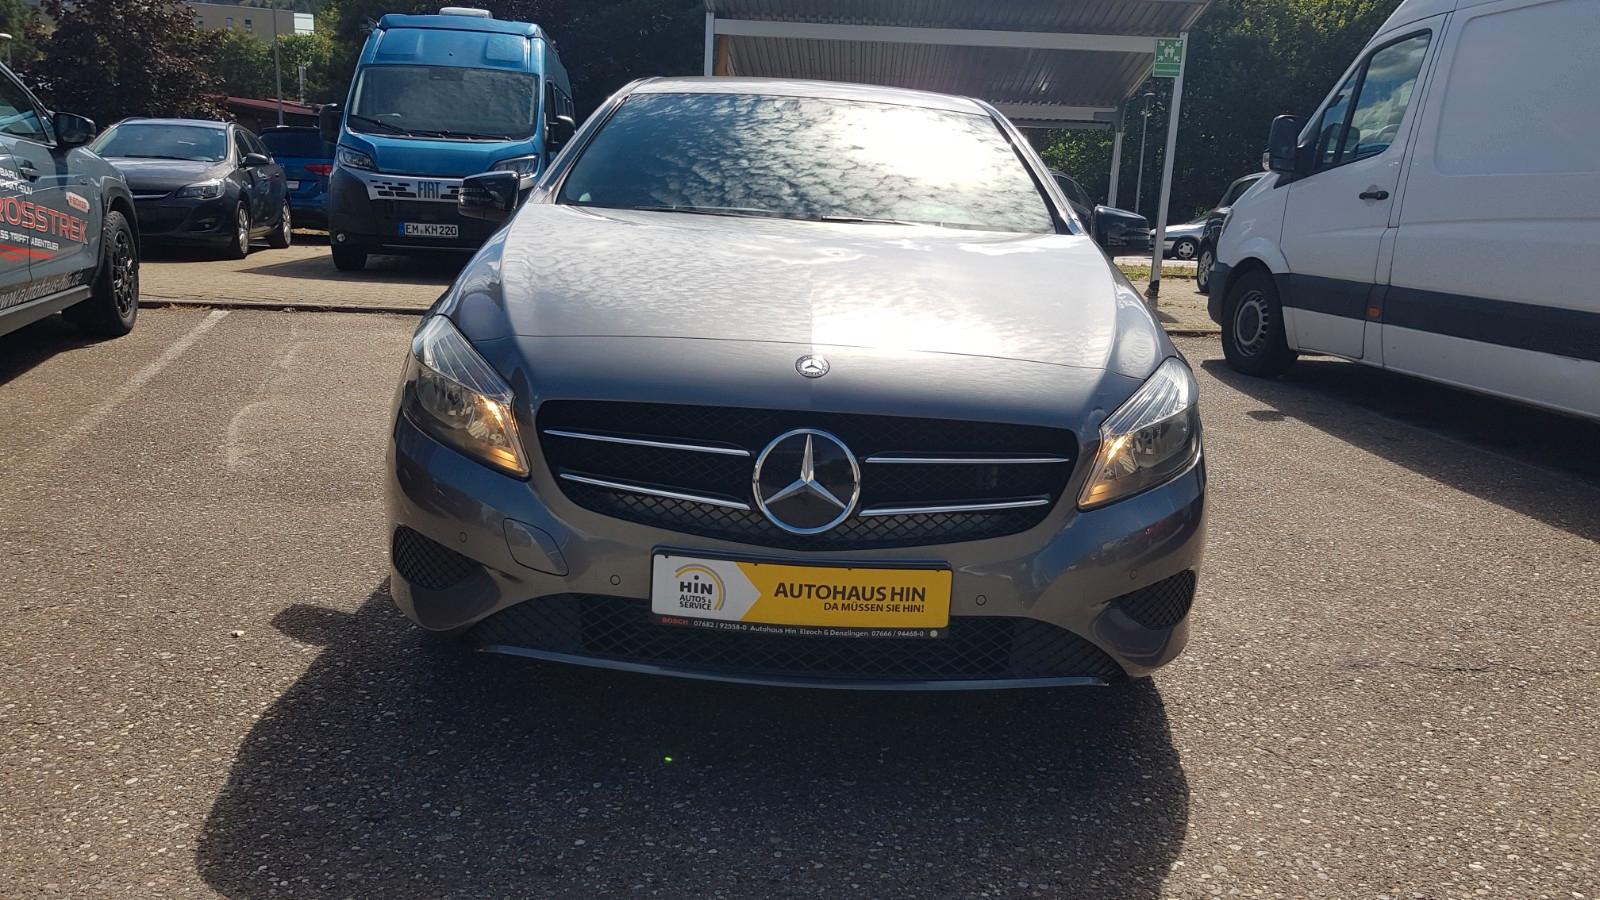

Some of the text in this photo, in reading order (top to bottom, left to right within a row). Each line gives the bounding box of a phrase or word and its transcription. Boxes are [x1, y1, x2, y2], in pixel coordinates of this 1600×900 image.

[417, 181, 440, 199] FIAT
[774, 582, 926, 602] AUTOHAUS HIN
[679, 594, 706, 603] AUTOS
[679, 601, 712, 611] SERVICE
[823, 601, 925, 613] DA MÜSSEN SIE HIN!
[750, 625, 784, 634] Autohaus
